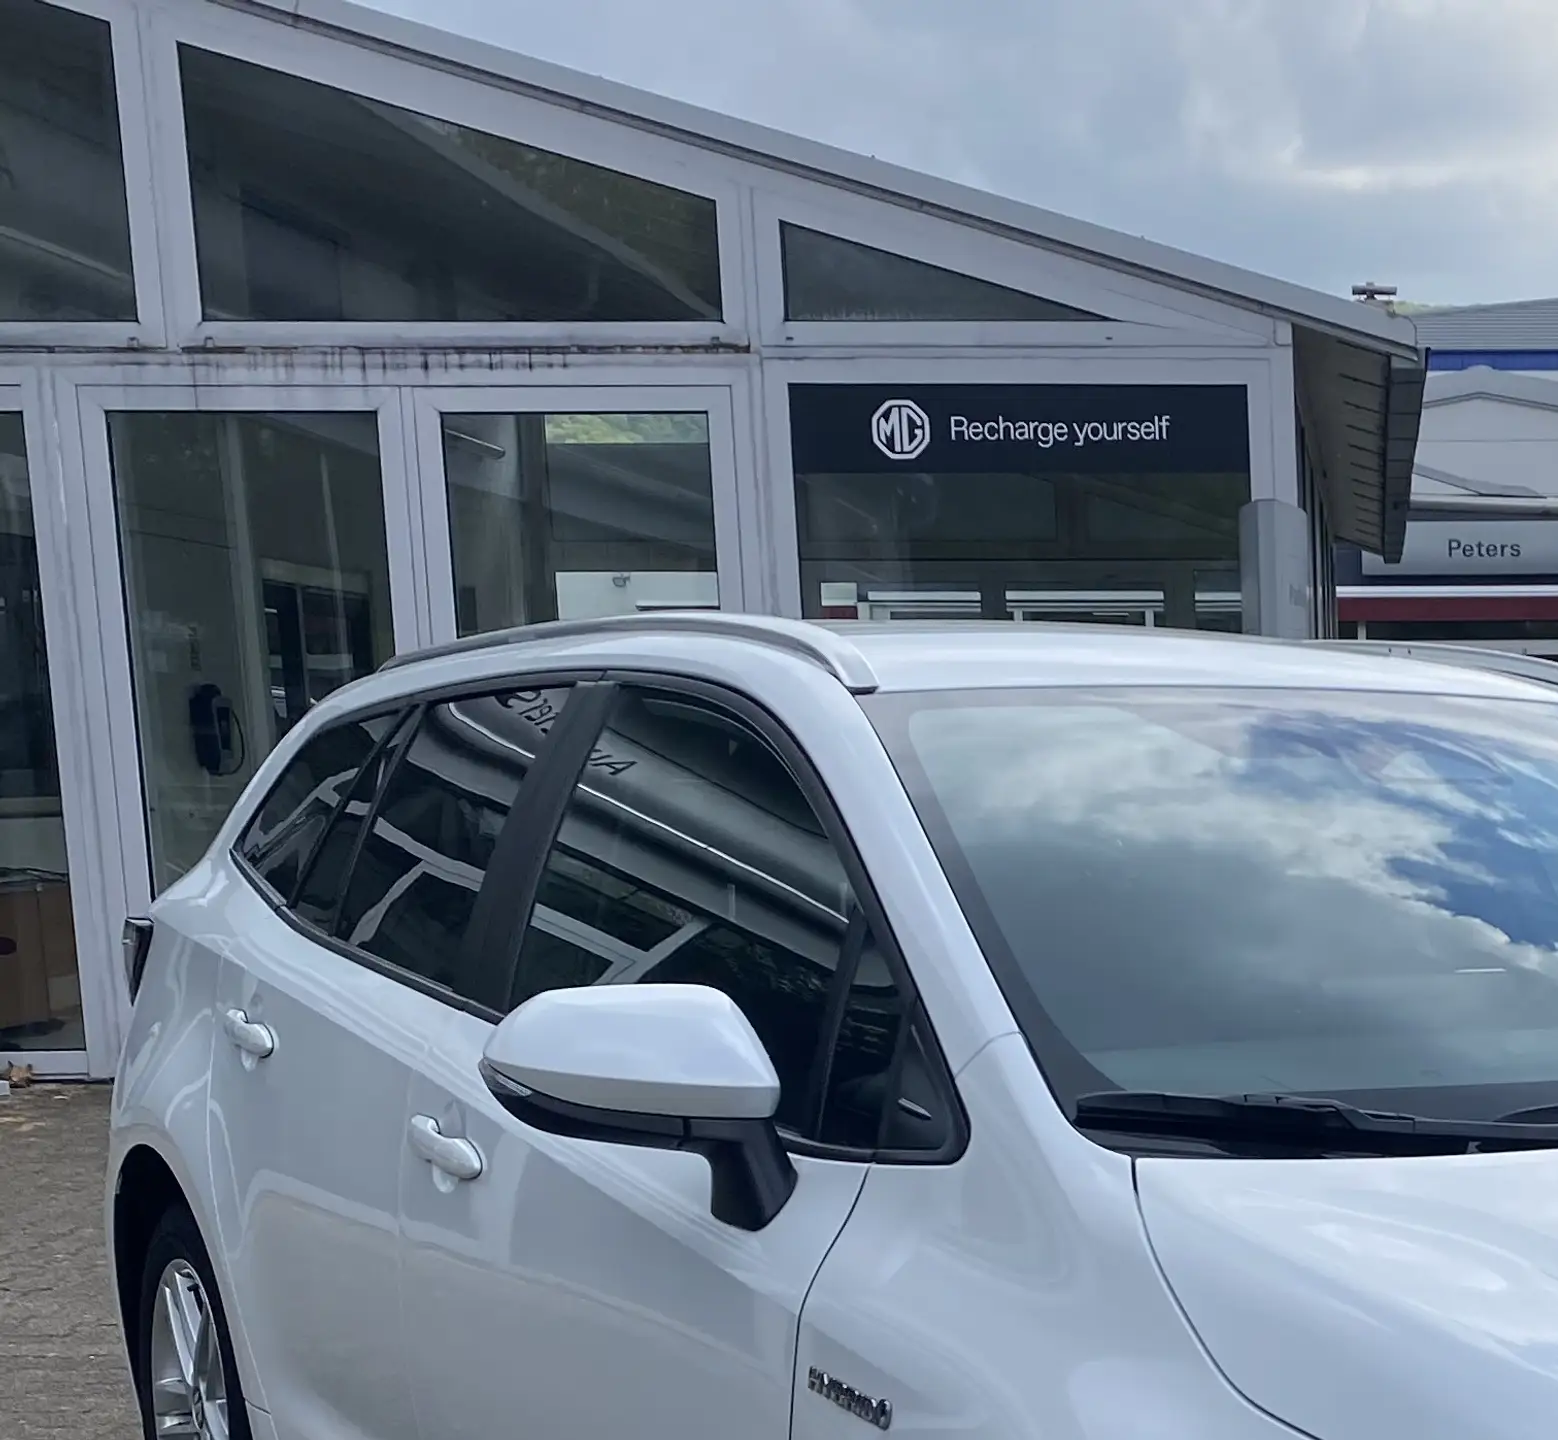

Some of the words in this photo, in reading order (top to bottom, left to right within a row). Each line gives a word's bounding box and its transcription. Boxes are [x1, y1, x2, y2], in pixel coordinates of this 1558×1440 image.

[876, 404, 926, 456] MG
[950, 415, 1068, 448] Recharge
[1073, 414, 1171, 446] yourself
[1447, 538, 1522, 558] Peters
